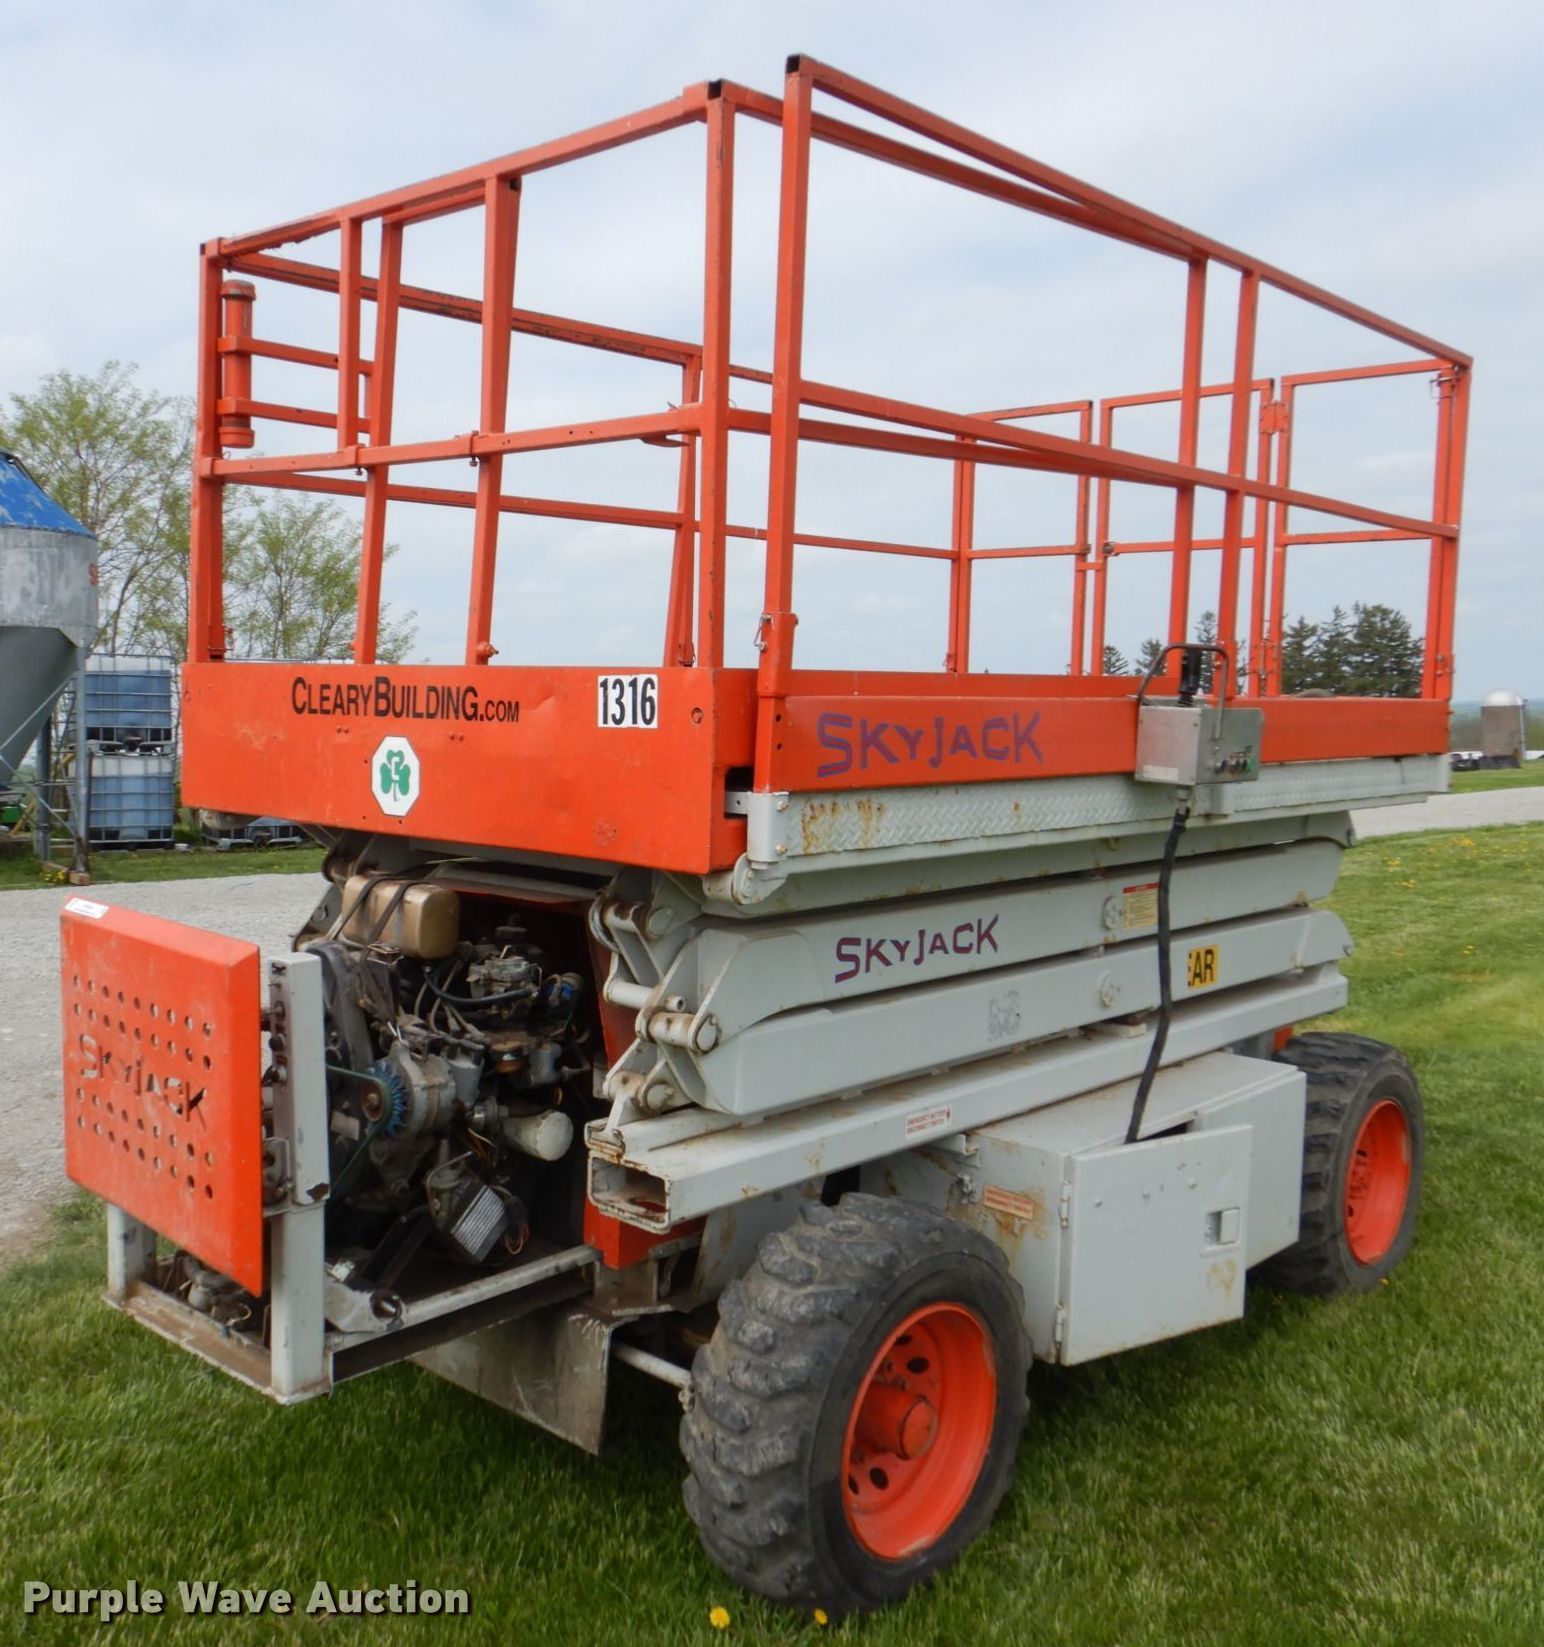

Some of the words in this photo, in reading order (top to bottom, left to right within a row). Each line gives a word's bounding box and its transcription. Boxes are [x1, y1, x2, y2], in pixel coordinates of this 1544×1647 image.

[599, 677, 656, 726] 1316
[816, 710, 1044, 778] SKYJACK
[834, 913, 1000, 984] SKYJACK
